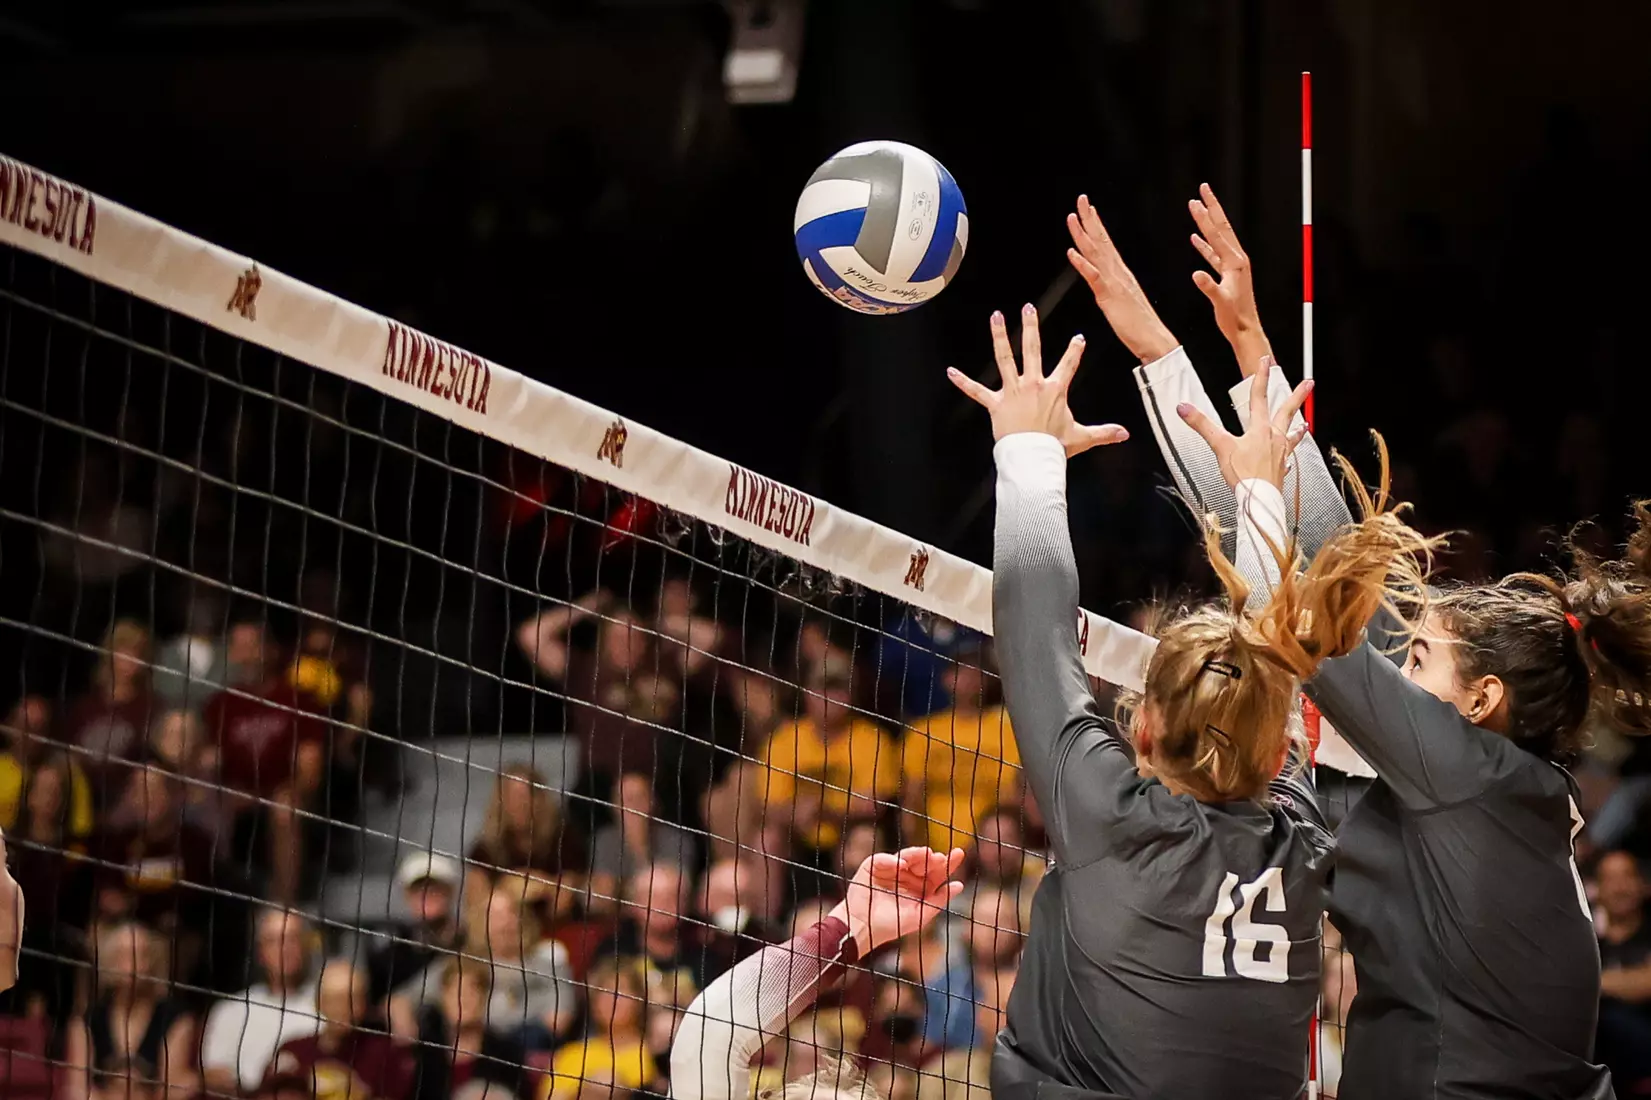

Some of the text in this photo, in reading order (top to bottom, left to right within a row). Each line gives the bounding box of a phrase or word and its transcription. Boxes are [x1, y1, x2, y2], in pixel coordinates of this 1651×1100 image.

[843, 266, 887, 292] Touch
[382, 318, 490, 414] MINNESOTA
[725, 464, 815, 547] MINNESOTA
[1203, 866, 1291, 984] 16
